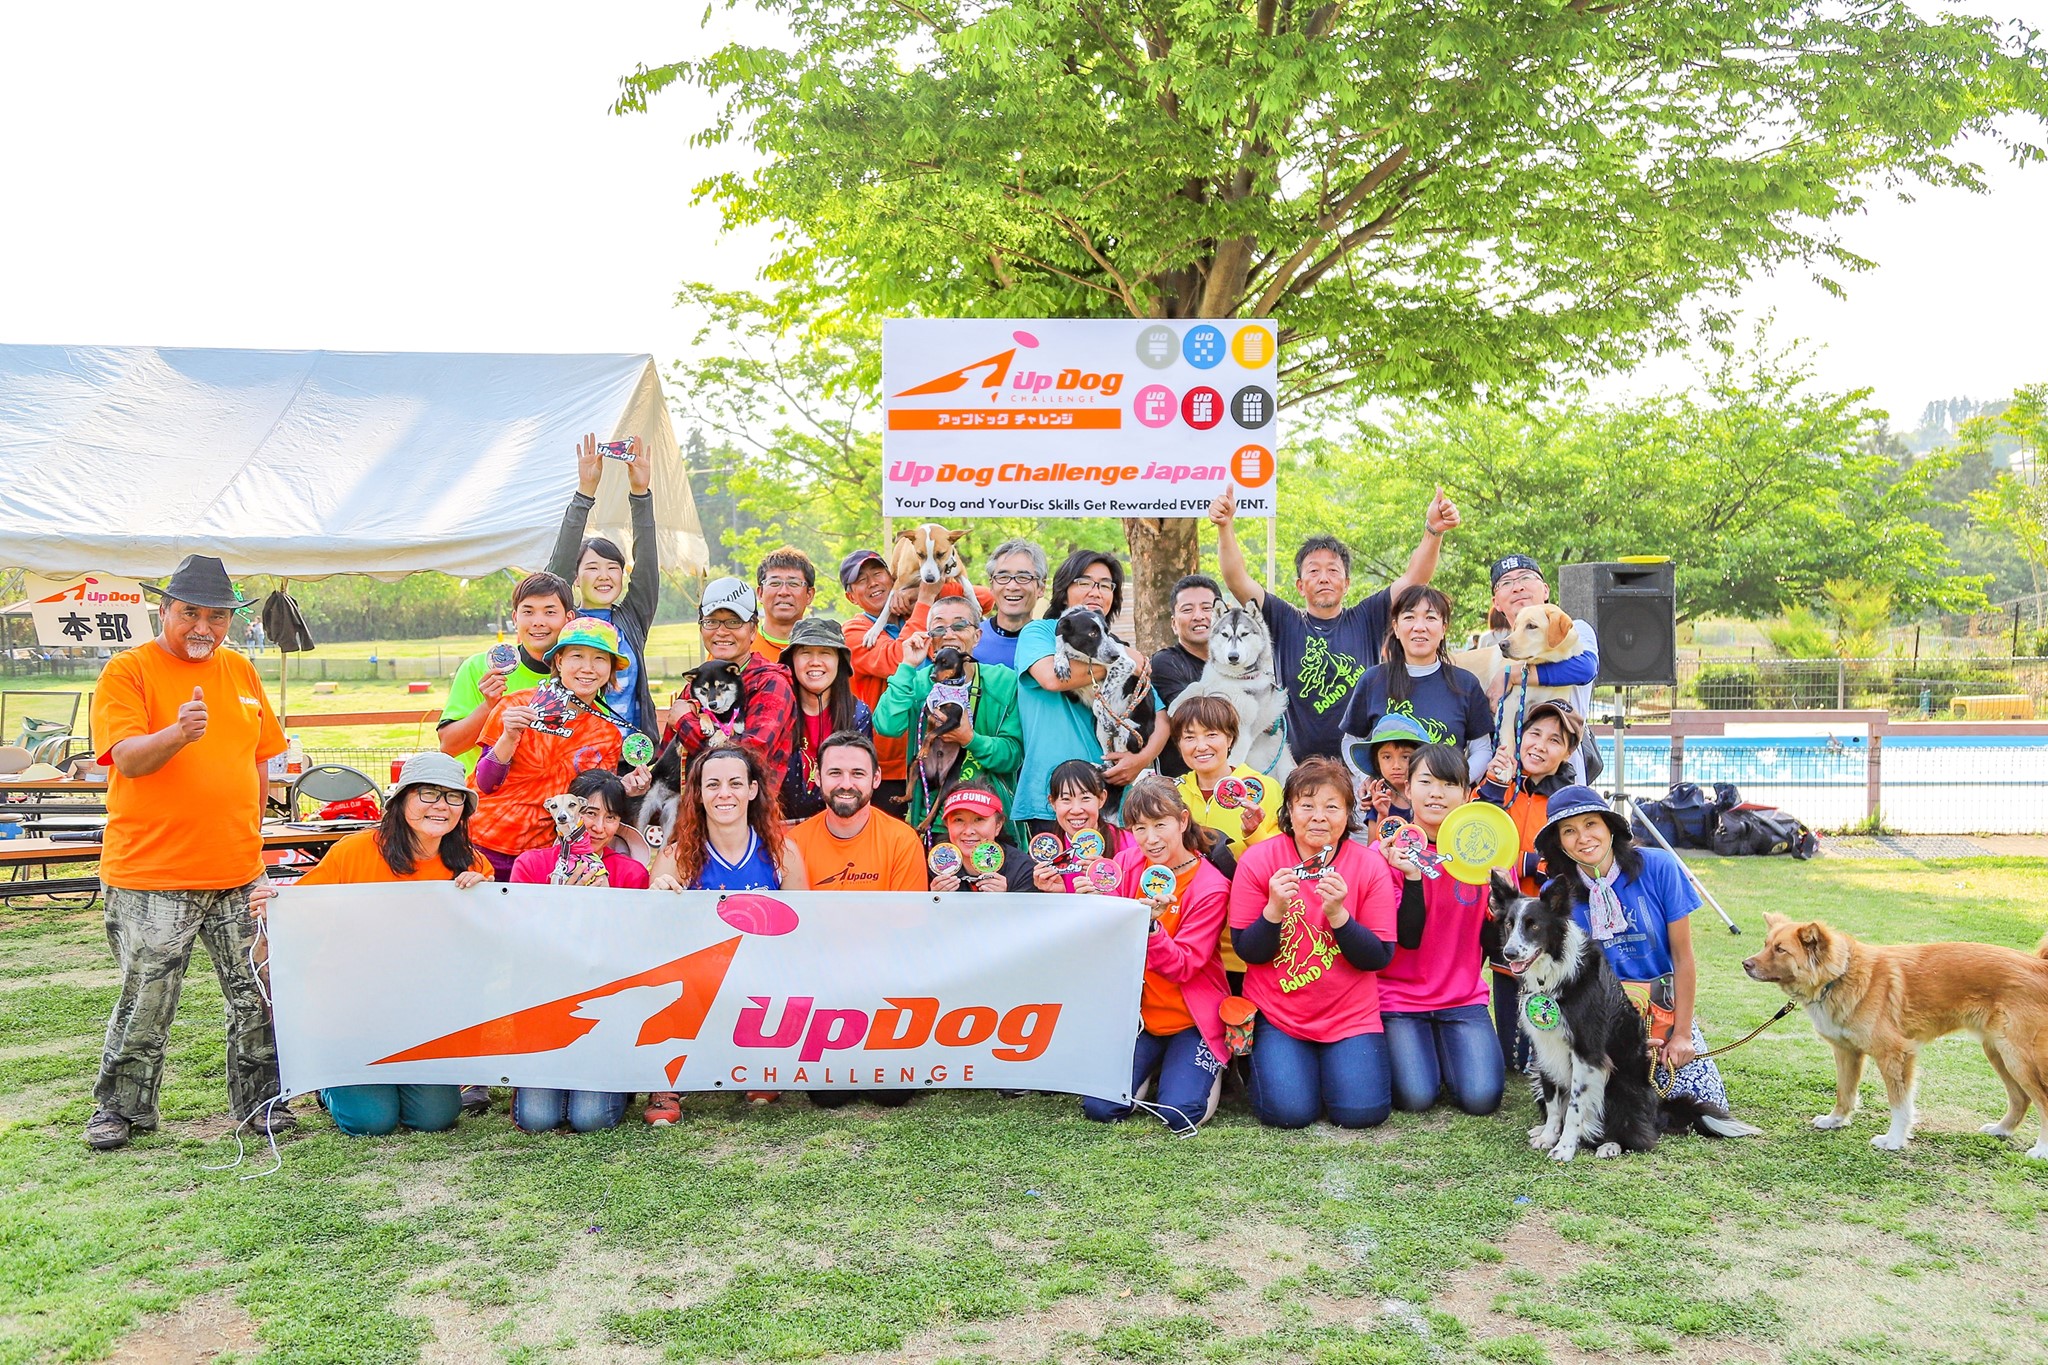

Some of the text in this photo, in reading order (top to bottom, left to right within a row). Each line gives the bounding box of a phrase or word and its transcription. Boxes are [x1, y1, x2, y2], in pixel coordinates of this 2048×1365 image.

[1011, 395, 1094, 403] CHALLENGE
[997, 463, 1139, 486] Challenge
[895, 497, 926, 508] Your
[929, 497, 956, 511] Dog
[959, 497, 984, 509] and
[988, 498, 1019, 510] Your
[1020, 499, 1044, 510] Disc
[1048, 499, 1080, 510] Skills
[1083, 499, 1107, 511] Get
[1110, 498, 1177, 511] Rewarded
[1180, 499, 1213, 510] EVER
[58, 611, 132, 642] 本部
[731, 1065, 974, 1083] CHALLENGE
